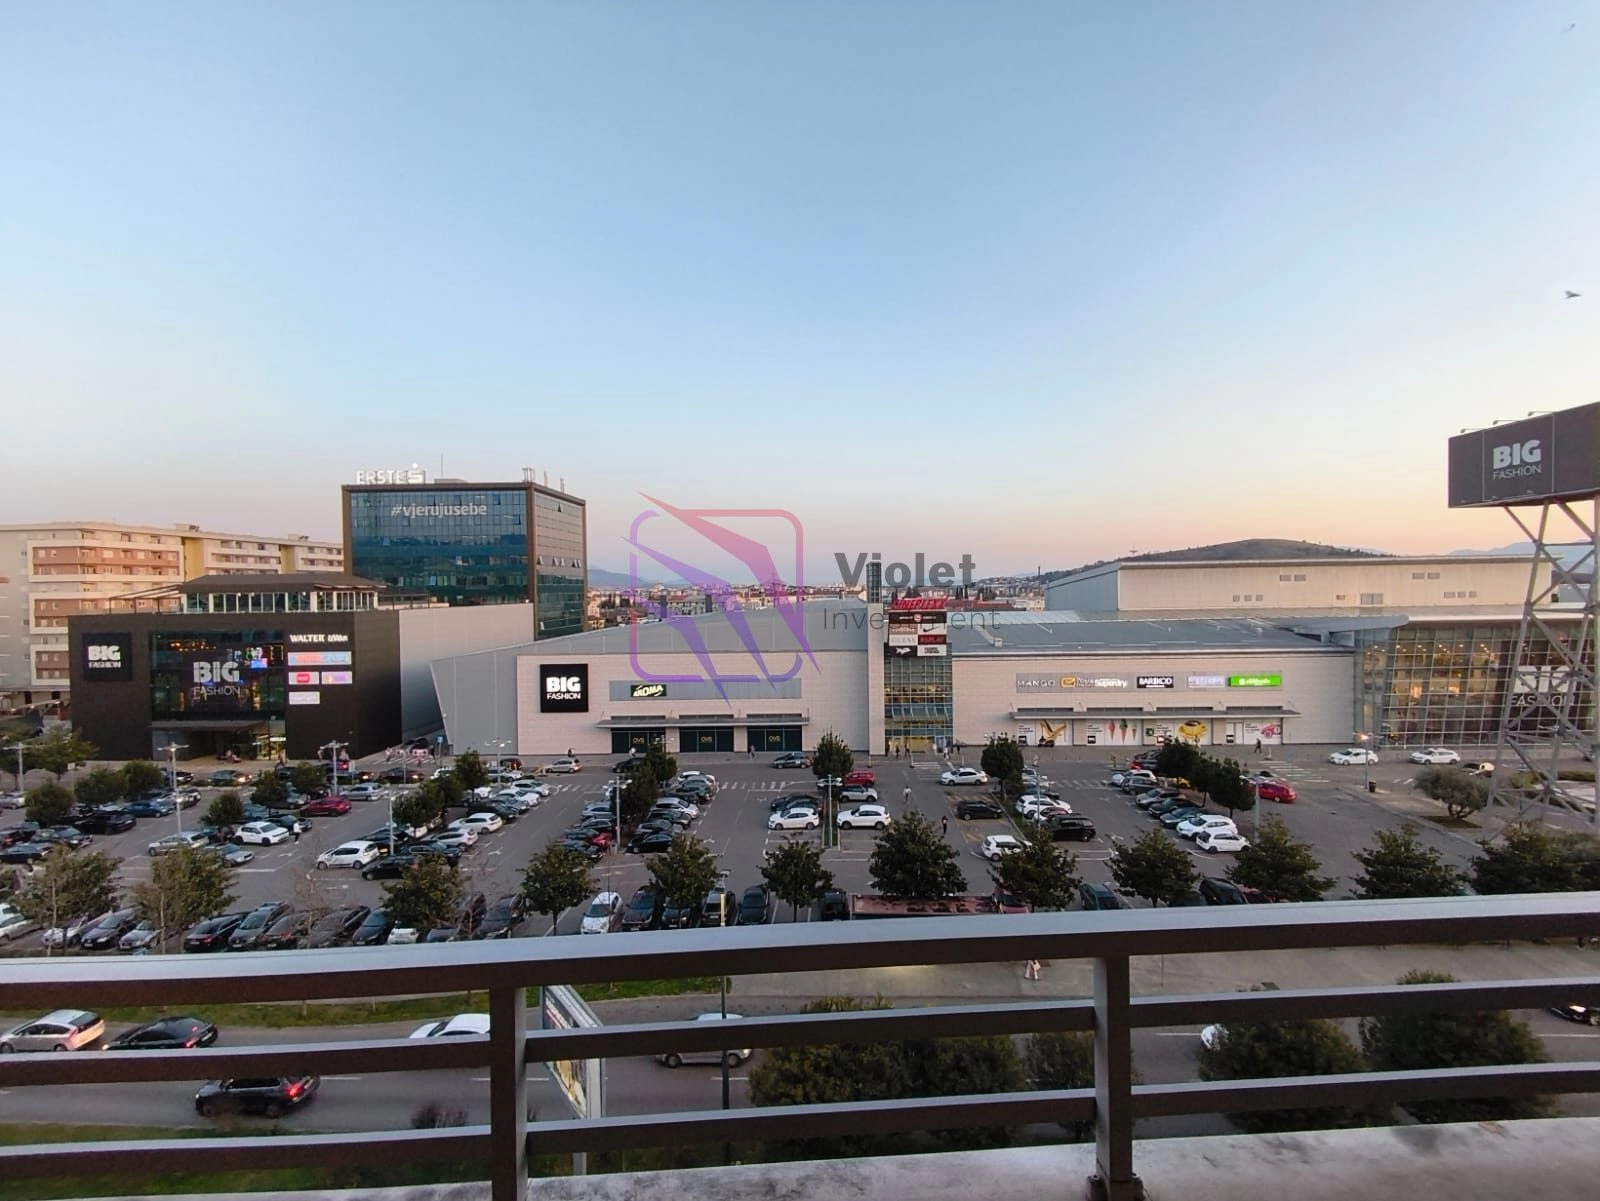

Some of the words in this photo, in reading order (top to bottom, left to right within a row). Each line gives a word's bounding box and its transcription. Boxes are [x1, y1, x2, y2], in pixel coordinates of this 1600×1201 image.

[1493, 439, 1541, 469] BIG
[356, 470, 407, 484] ERSTE
[1493, 465, 1542, 480] FASHION
[391, 503, 487, 518] #vjerujusebe
[290, 634, 325, 642] WALTER
[88, 645, 121, 661] BIG
[88, 661, 121, 669] FASHION
[193, 661, 239, 682] BIG
[546, 677, 581, 692] BIG
[1017, 679, 1056, 688] MANGO
[193, 686, 240, 696] FASHION
[546, 692, 581, 700] FASHION
[1511, 695, 1575, 706] FASION
